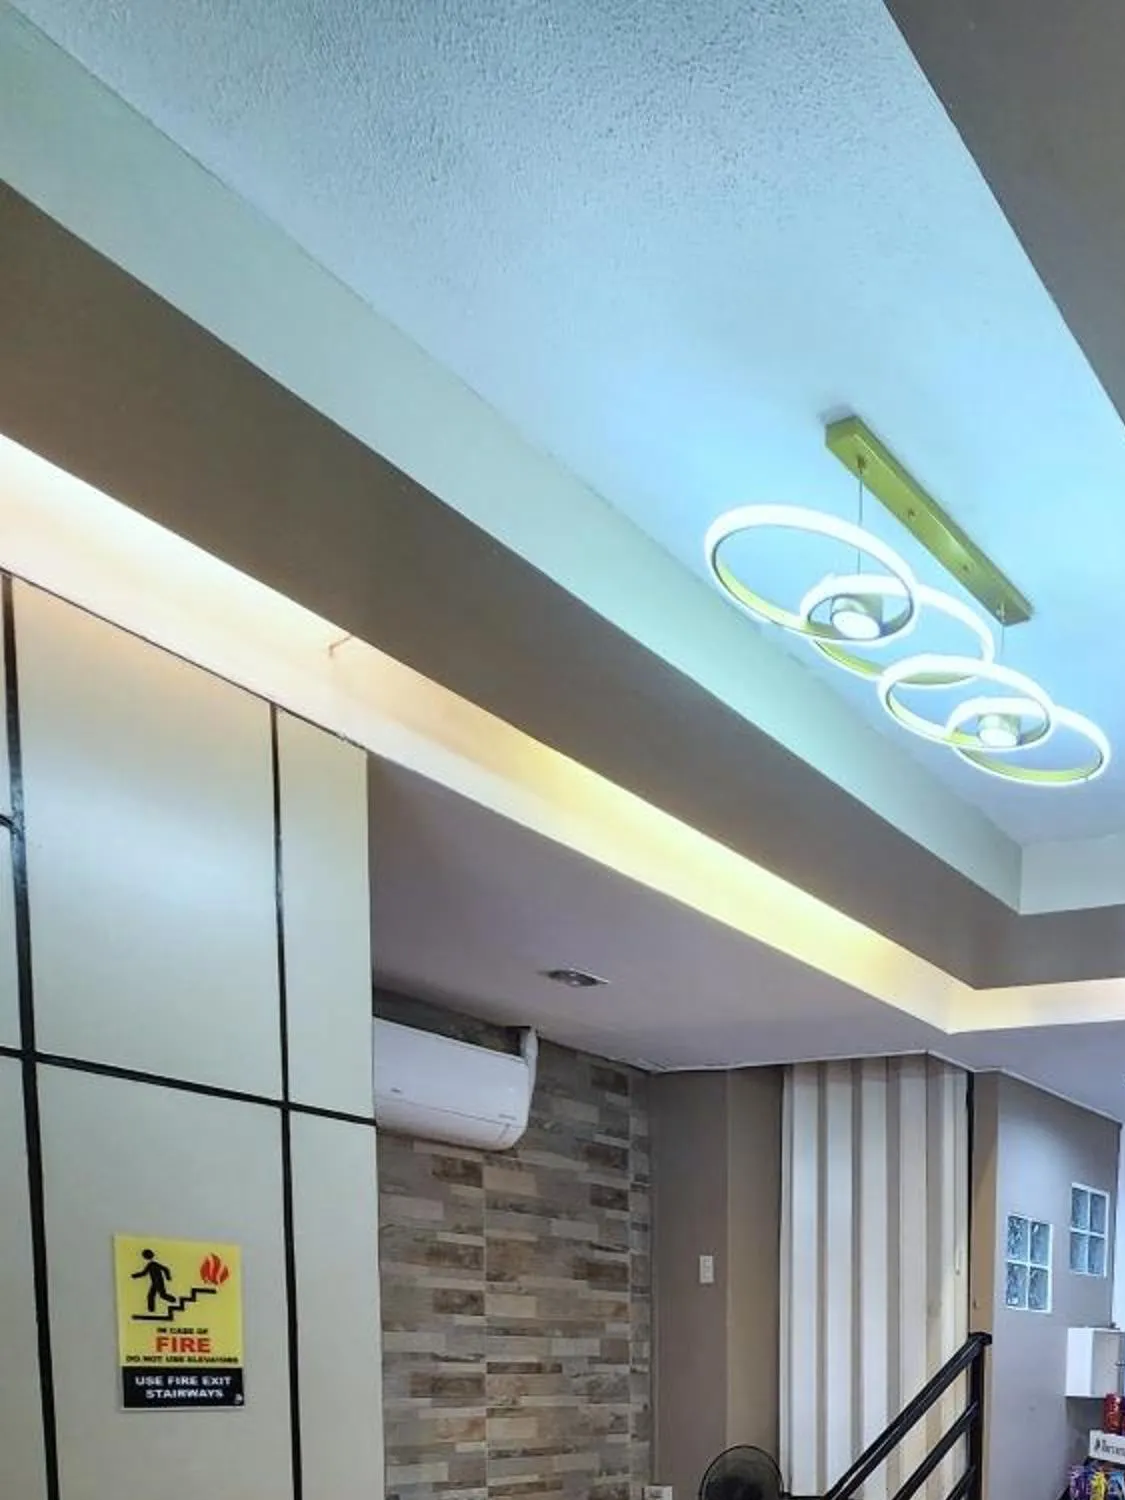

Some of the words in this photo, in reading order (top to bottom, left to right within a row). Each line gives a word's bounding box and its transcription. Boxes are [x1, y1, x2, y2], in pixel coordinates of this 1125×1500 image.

[156, 1336, 211, 1353] FIRE
[135, 1375, 163, 1386] USE
[167, 1375, 198, 1386] FIRE
[202, 1375, 232, 1386] EXIT
[145, 1388, 224, 1399] STAIRWAYS
